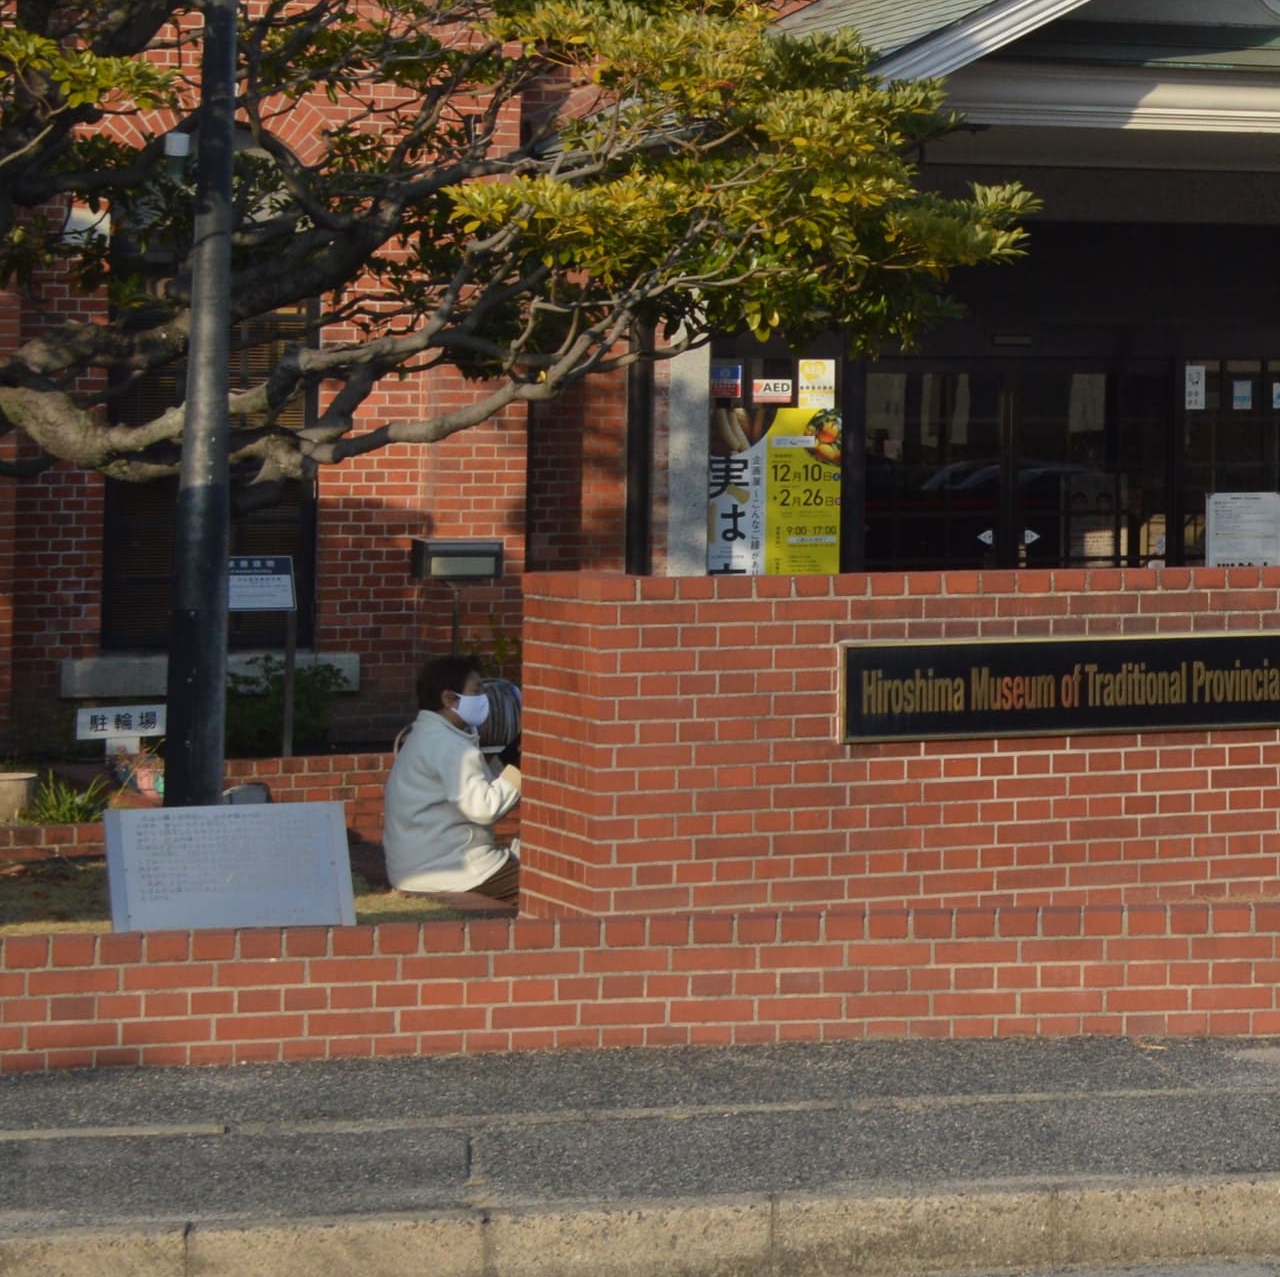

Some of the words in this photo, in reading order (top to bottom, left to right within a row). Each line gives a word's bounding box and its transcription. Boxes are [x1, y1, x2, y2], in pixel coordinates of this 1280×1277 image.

[763, 382, 790, 392] AED
[862, 668, 965, 715] Hiroshima
[971, 666, 1055, 711] Museum
[1061, 664, 1080, 708] of
[1084, 661, 1187, 707] Traditional
[90, 711, 158, 732] 駐輪場
